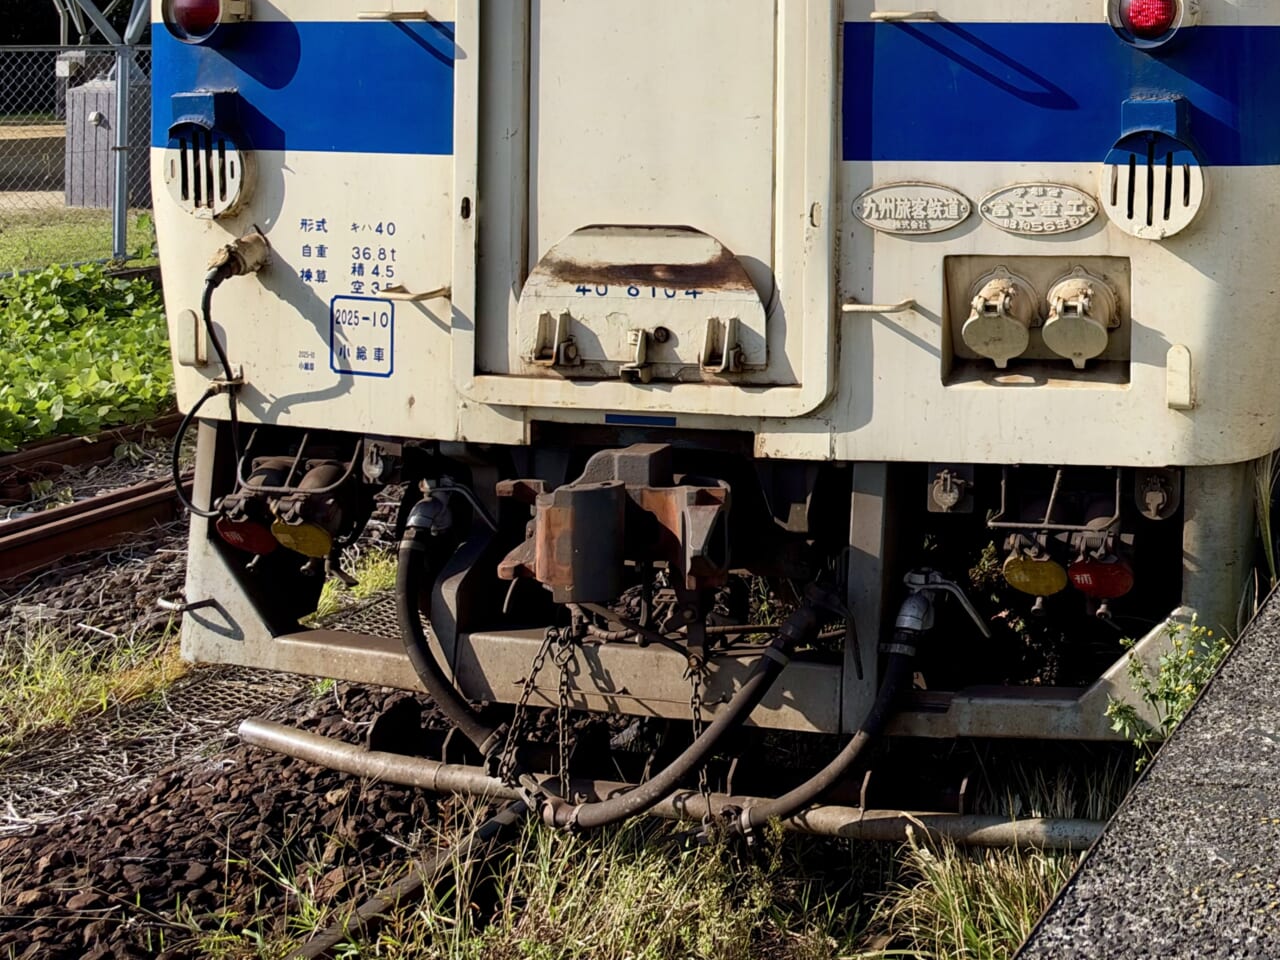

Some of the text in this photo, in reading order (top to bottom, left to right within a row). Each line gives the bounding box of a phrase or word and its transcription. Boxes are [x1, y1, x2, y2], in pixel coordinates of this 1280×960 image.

[990, 200, 1086, 217] 富士重工
[300, 218, 396, 236] 形式 キハ40
[302, 244, 328, 258] 自重
[300, 268, 328, 283] 換算
[335, 308, 389, 328] 2025-10
